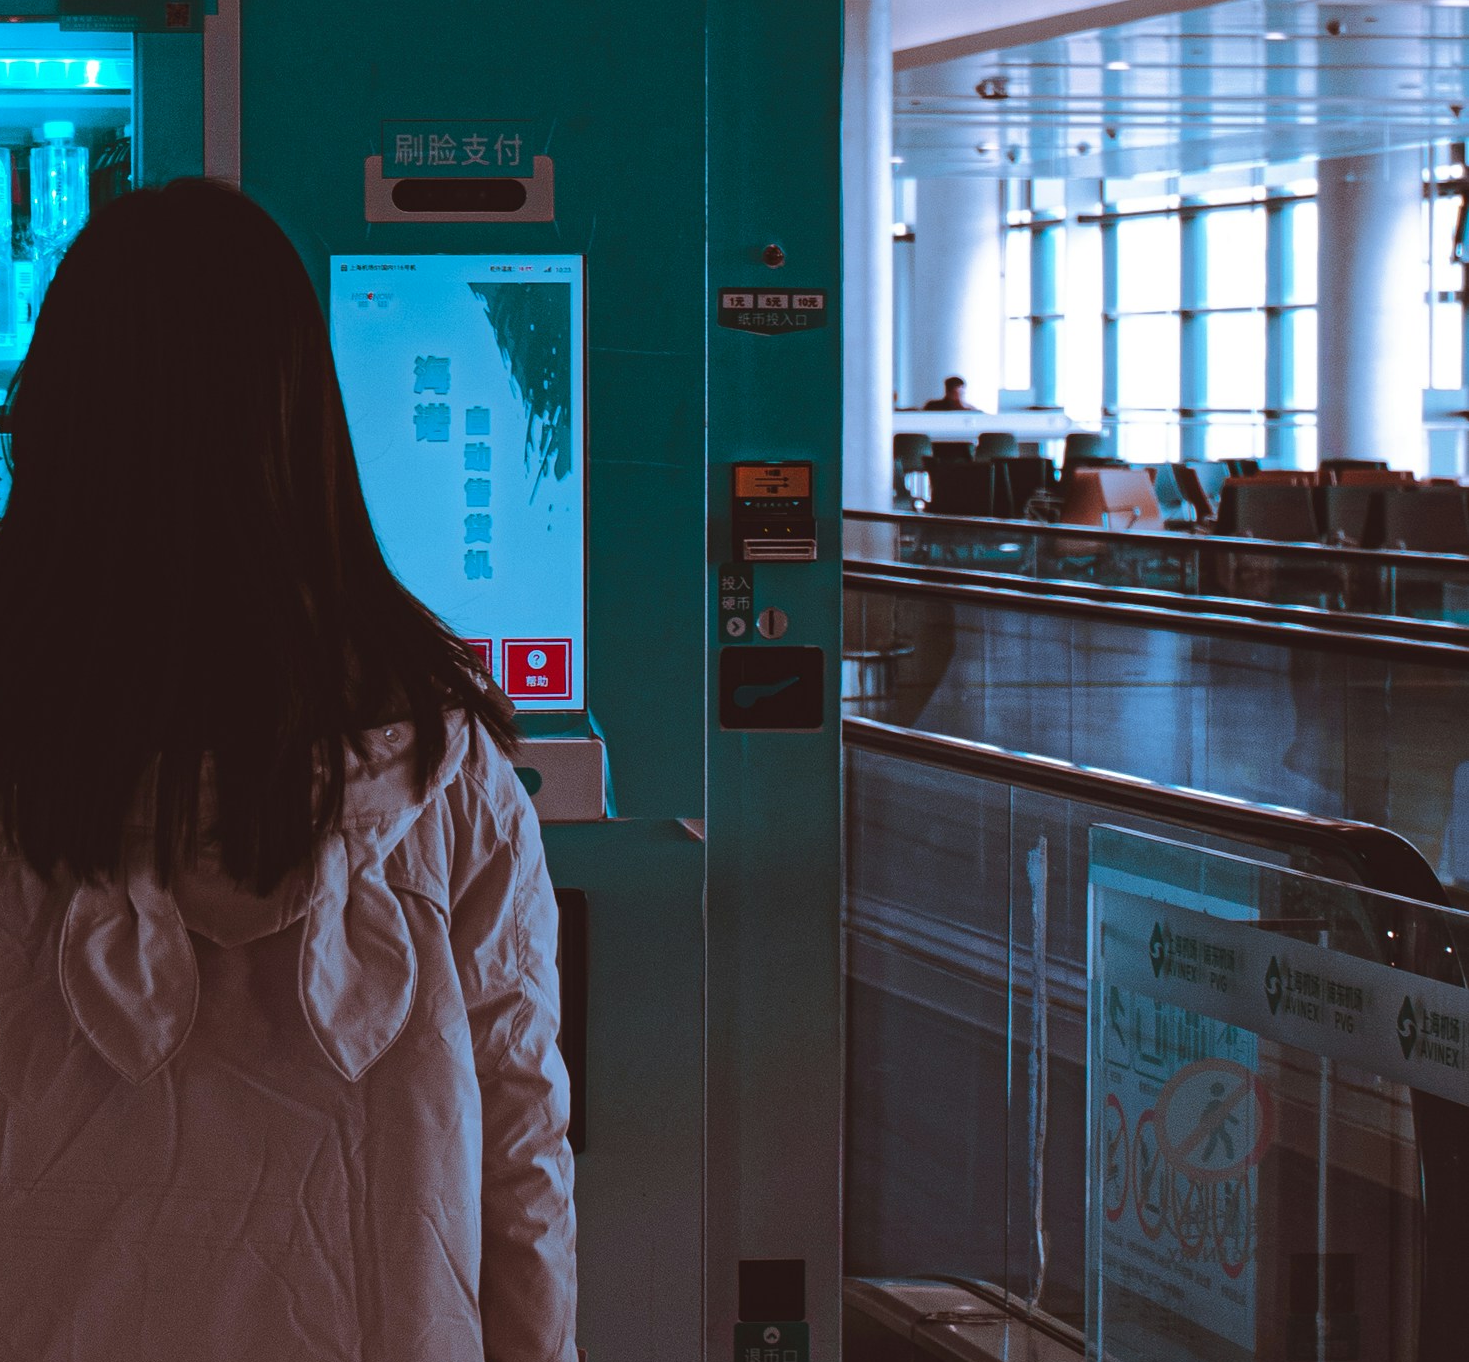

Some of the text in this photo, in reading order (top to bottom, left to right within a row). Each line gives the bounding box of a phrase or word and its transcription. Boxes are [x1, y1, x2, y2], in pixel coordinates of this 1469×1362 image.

[394, 132, 523, 167] 刷脸支付
[729, 296, 746, 308] 1元
[765, 297, 782, 308] 5元
[797, 297, 818, 308] 10元
[737, 312, 808, 327] 纸币投入口
[721, 575, 752, 591] 投入
[721, 595, 752, 612] 硬币
[525, 675, 549, 689] 帮助
[1167, 936, 1197, 962] 上海机场
[1209, 971, 1228, 993] PVG
[1286, 968, 1320, 999] 上海机场
[1285, 995, 1354, 1034] AVINEX PVG
[1420, 1008, 1460, 1044] 上海机场
[1420, 1036, 1460, 1070] AVINEX
